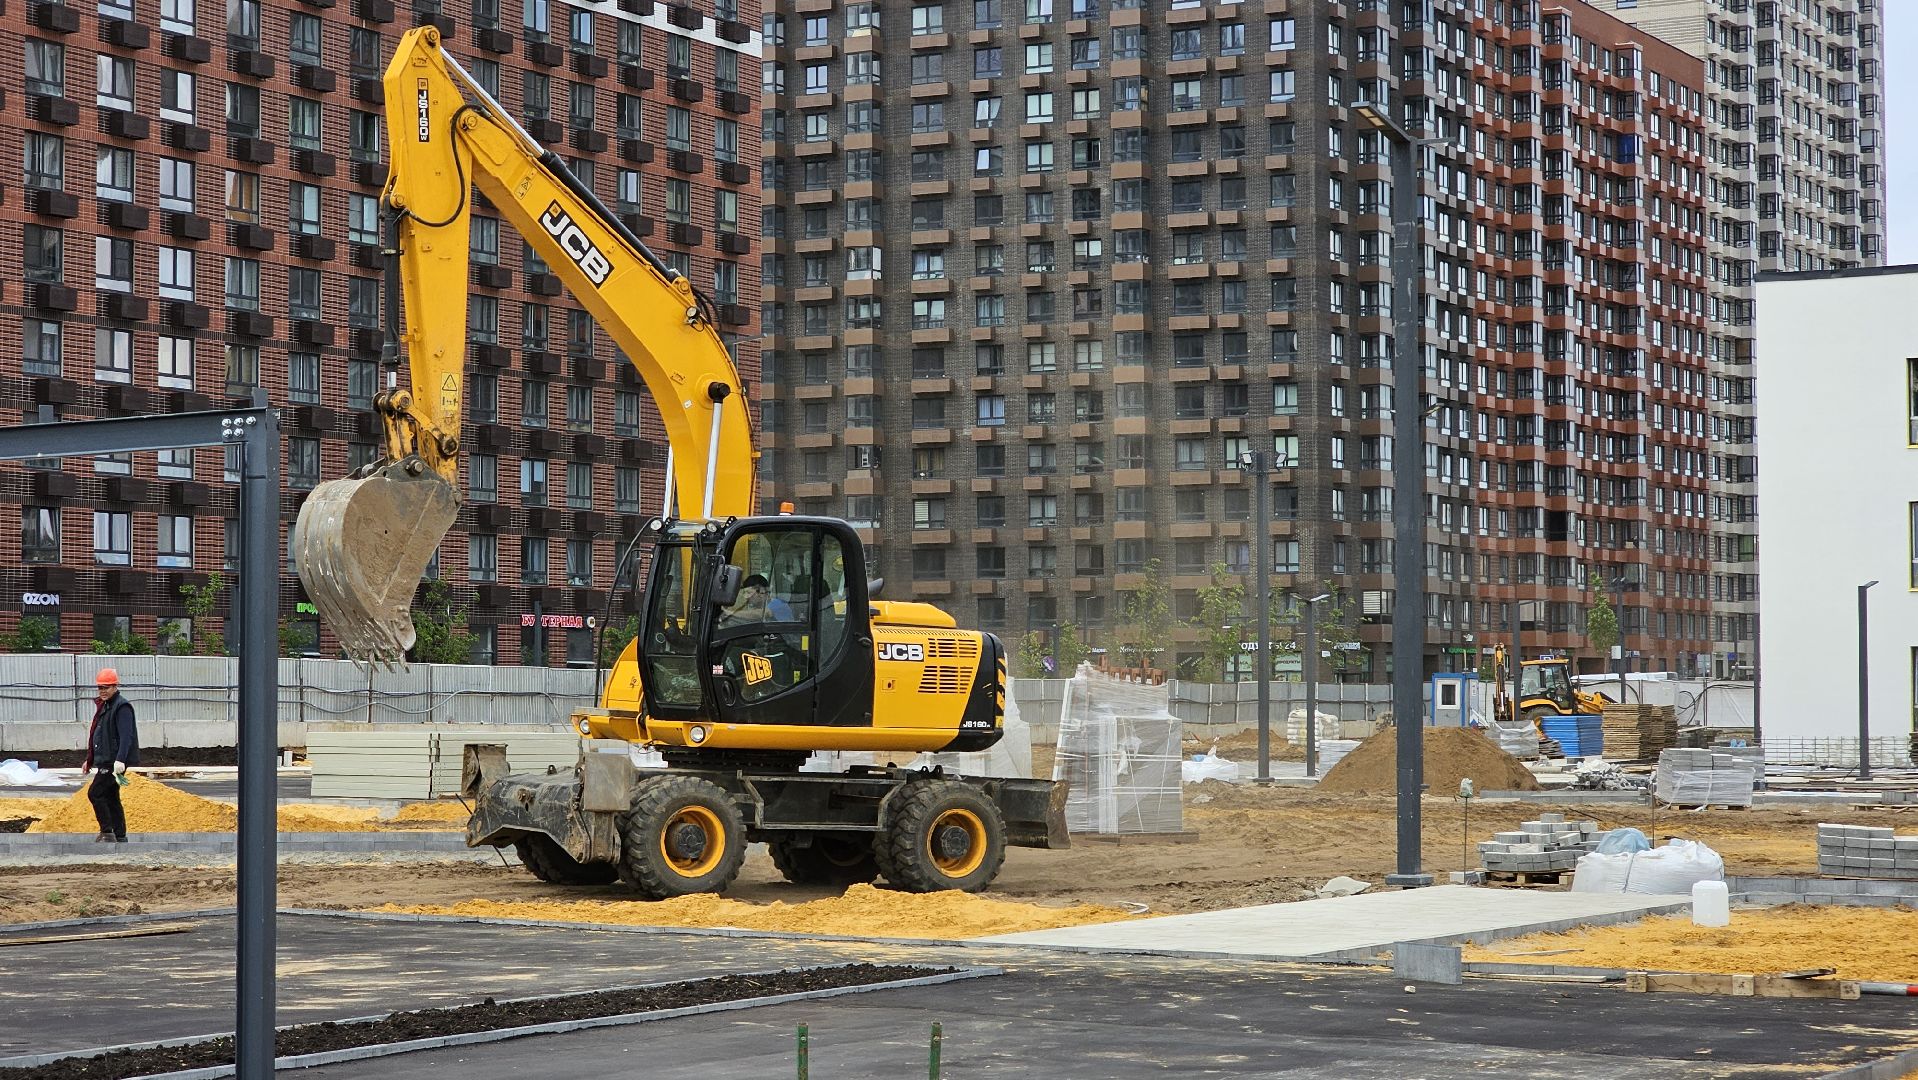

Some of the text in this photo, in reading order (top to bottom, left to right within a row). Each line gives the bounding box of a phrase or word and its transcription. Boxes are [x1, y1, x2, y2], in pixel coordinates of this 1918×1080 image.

[542, 212, 610, 284] JCB
[23, 592, 59, 605] OZON
[521, 614, 583, 628] БУГЕРНАЯ
[878, 643, 924, 661] JCB
[747, 656, 771, 682] JCB
